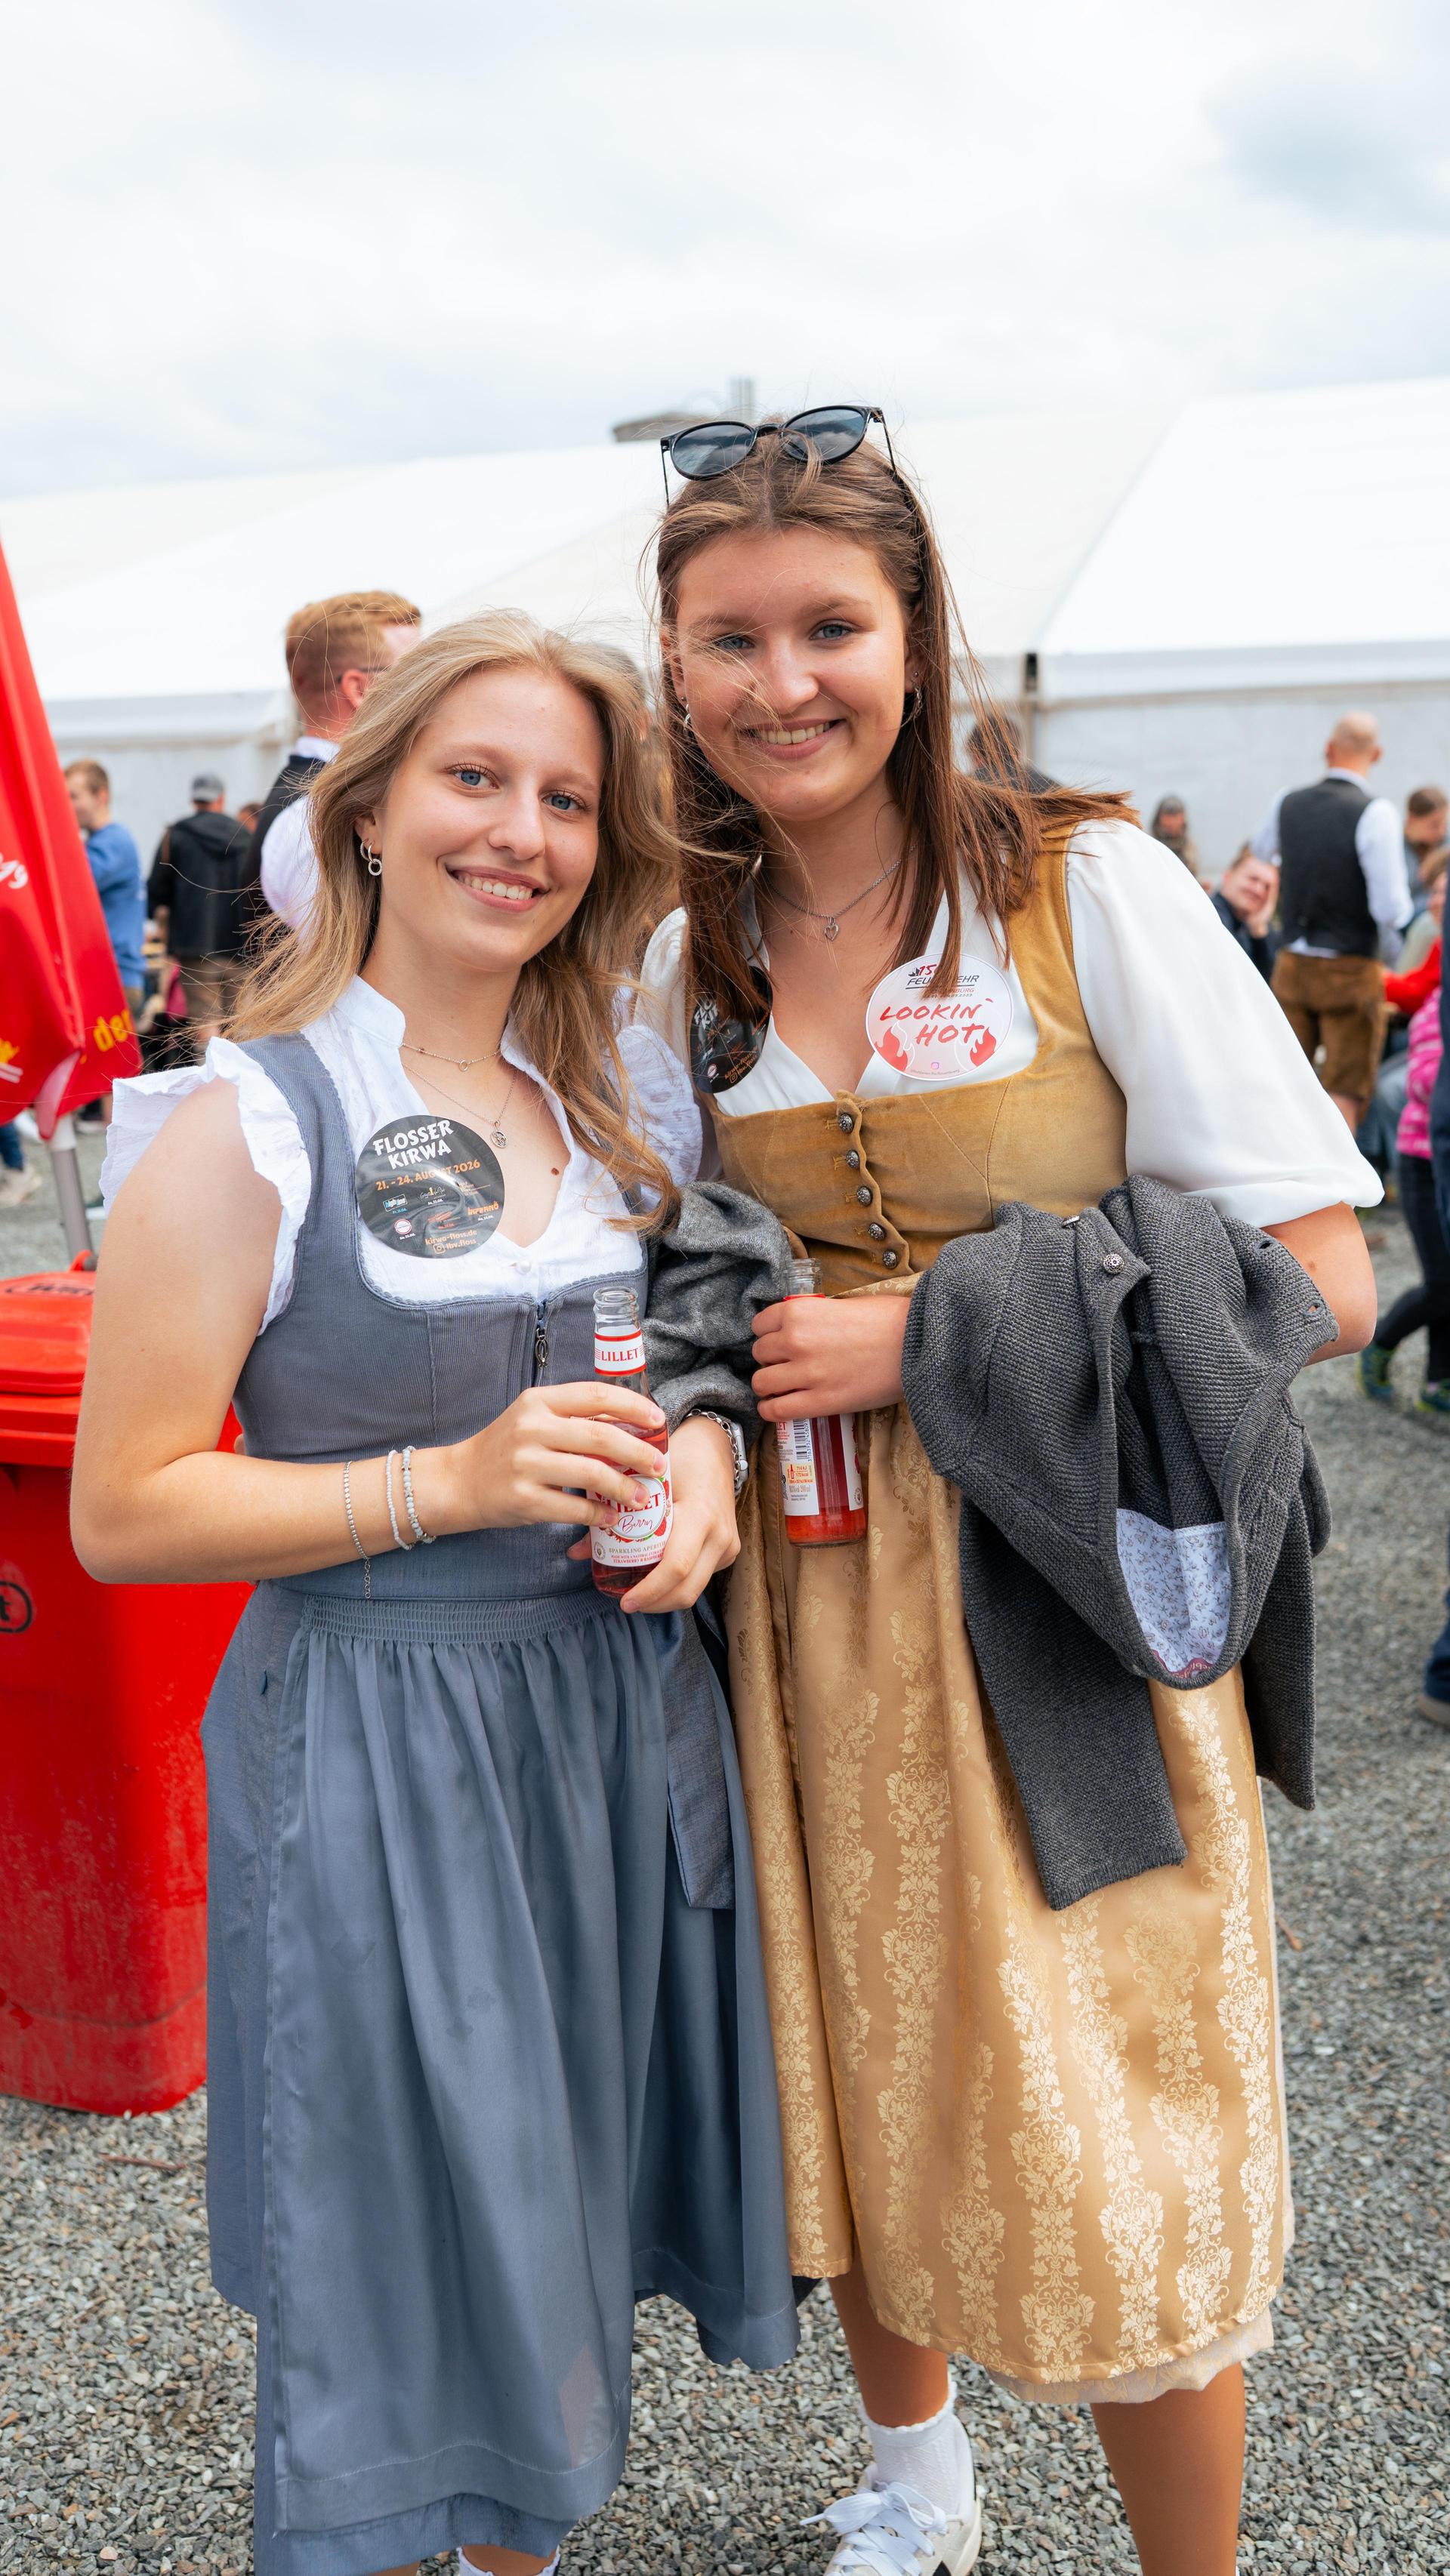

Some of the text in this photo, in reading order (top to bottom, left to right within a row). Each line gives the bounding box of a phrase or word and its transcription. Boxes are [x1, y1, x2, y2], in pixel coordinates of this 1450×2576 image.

[907, 975, 980, 986] FEUEHR
[914, 1023, 985, 1047] HOT
[372, 1120, 454, 1157] FLOSSER
[387, 1139, 452, 1170] KIRWA
[375, 1180, 390, 1191] 21.
[396, 1175, 414, 1185] 24.
[415, 1166, 452, 1182] AUGST
[453, 1159, 480, 1173] 2026
[601, 1348, 638, 1361] LILLET
[618, 1514, 653, 1533] Berry
[609, 1545, 641, 1554] SPARKLING
